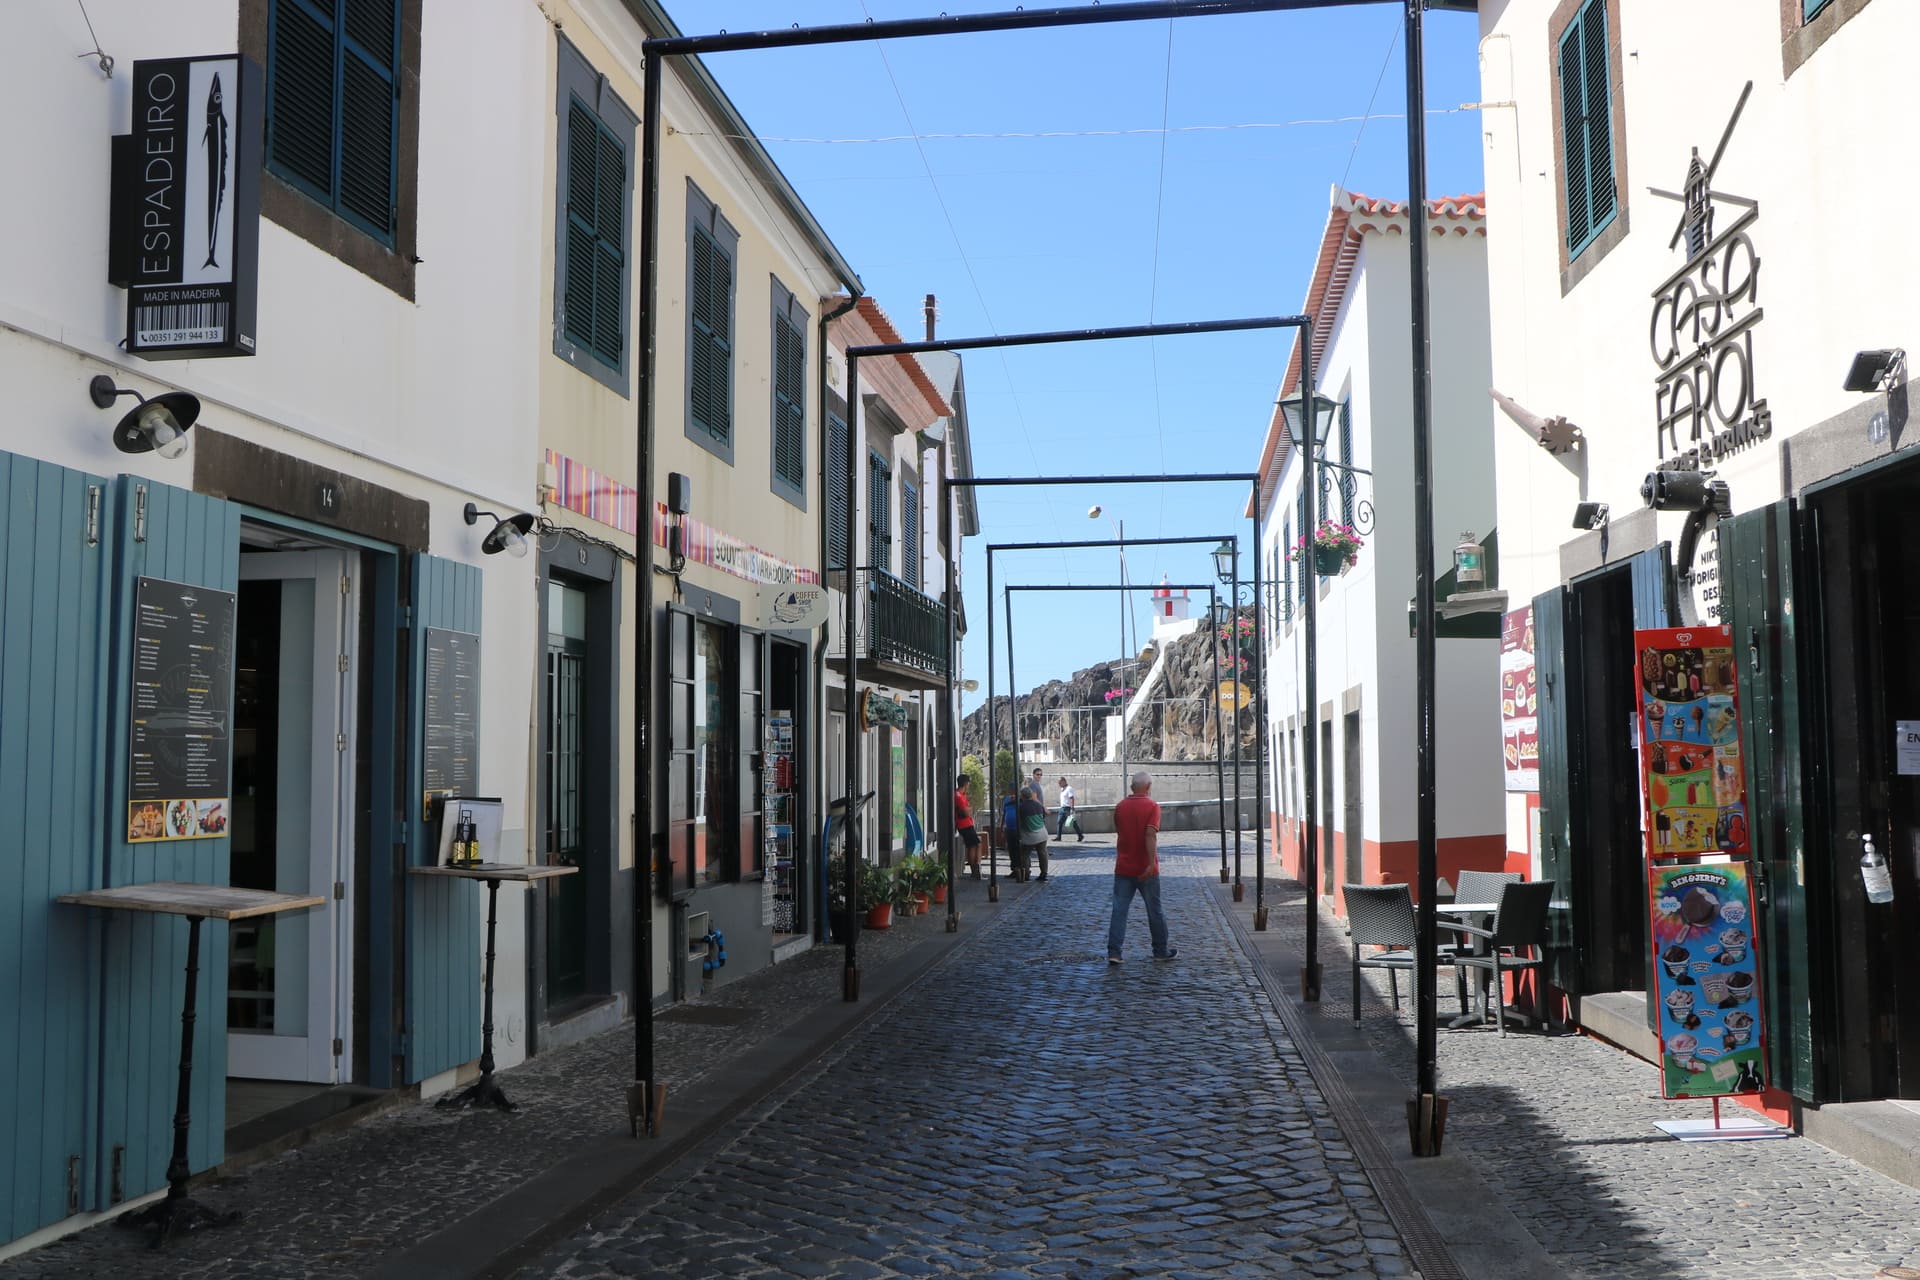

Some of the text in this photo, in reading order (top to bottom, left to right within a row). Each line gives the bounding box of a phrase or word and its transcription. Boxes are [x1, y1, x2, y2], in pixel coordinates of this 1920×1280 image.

[142, 73, 176, 273] ESPADEIRO
[143, 288, 221, 302] MADE IN MADEIRA
[149, 330, 218, 342] 00351 291 944 133
[1656, 330, 1767, 460] FAROL
[1700, 442, 1713, 466] &
[1712, 410, 1772, 459] DRINKS
[322, 487, 332, 507] 14
[1696, 568, 1719, 585] ORIGI
[795, 591, 818, 599] COFFEE
[1703, 586, 1720, 602] DES
[1907, 732, 1920, 743] EN
